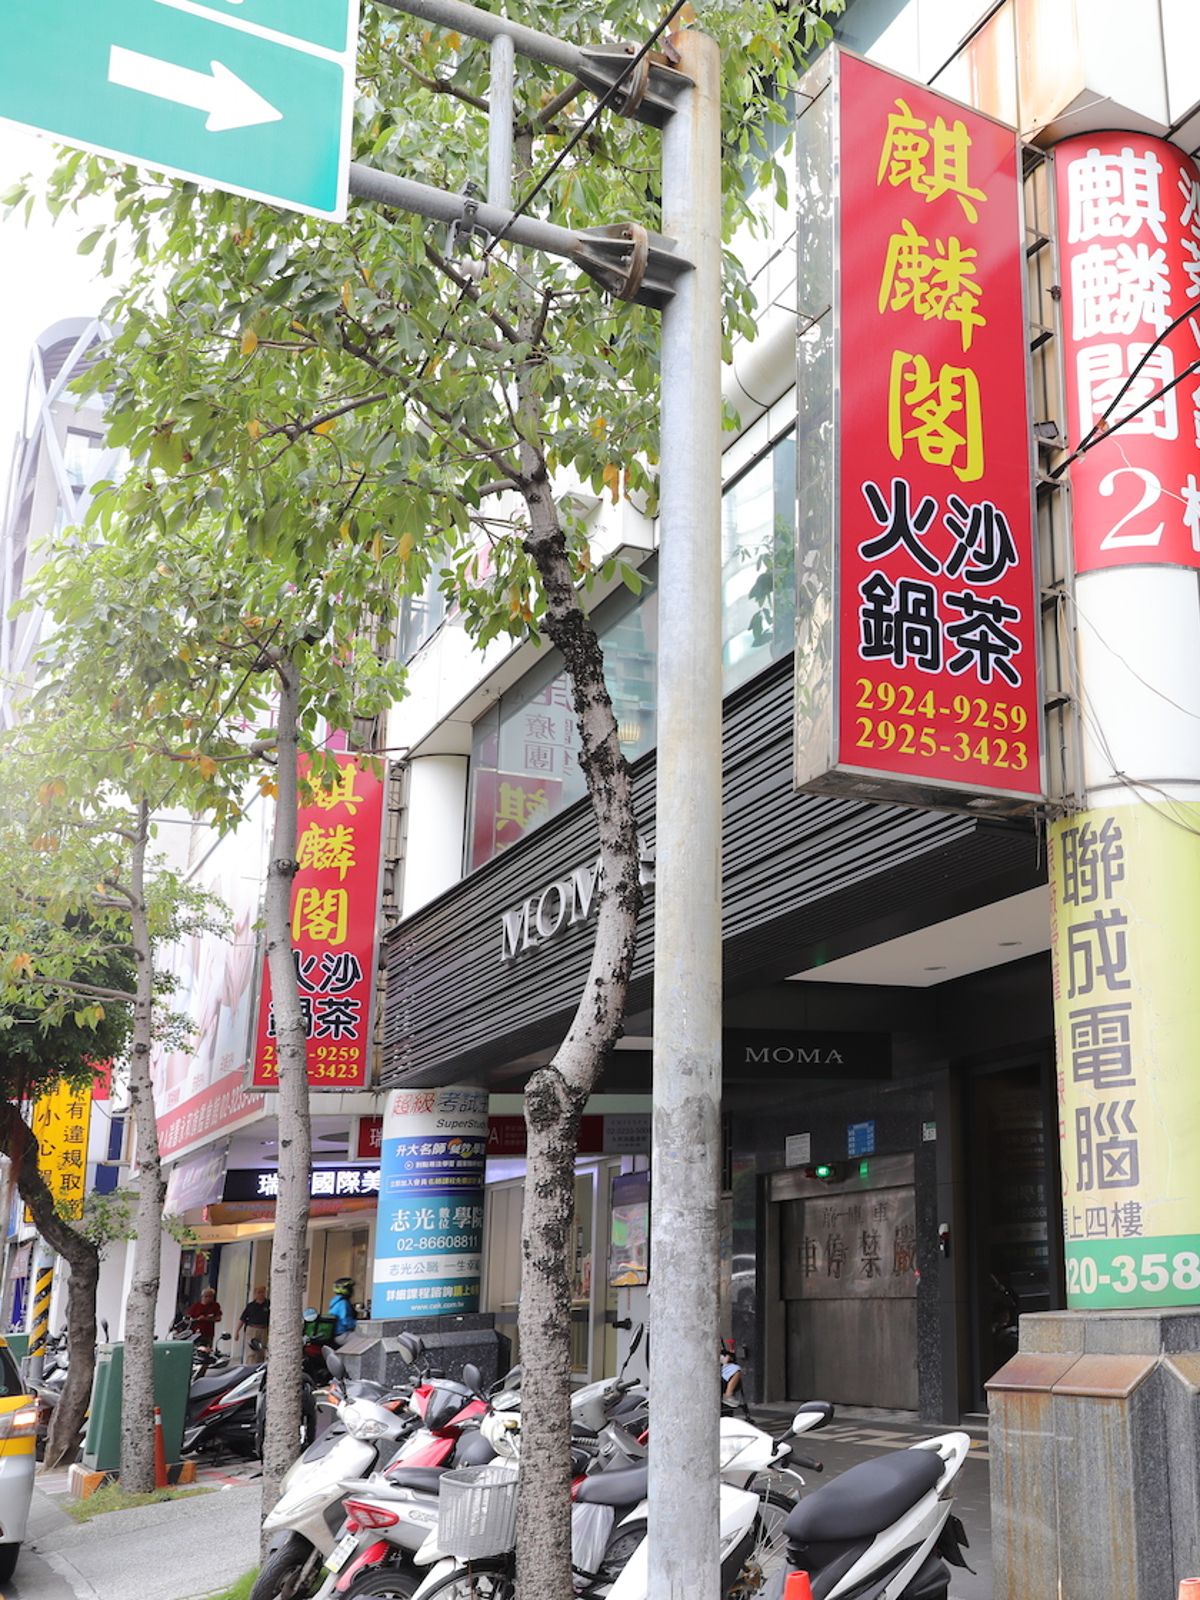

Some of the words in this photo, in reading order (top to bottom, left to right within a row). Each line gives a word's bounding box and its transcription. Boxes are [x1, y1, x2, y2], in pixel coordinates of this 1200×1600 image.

[876, 98, 989, 482] 麒麟閣
[1066, 146, 1180, 442] 麒麟閣
[856, 677, 1029, 735] 2924-9259
[856, 716, 1029, 771] 2925-3423
[500, 835, 656, 962] MOM
[316, 951, 364, 1040] 沙茶
[1060, 817, 1140, 1192] 聯成電腦
[262, 1063, 359, 1079] 29-3423
[263, 1045, 360, 1062] 2-9259
[745, 1046, 845, 1065] MOMA
[257, 1170, 382, 1197] 瑞國際美
[1064, 1200, 1144, 1241] 上四樓
